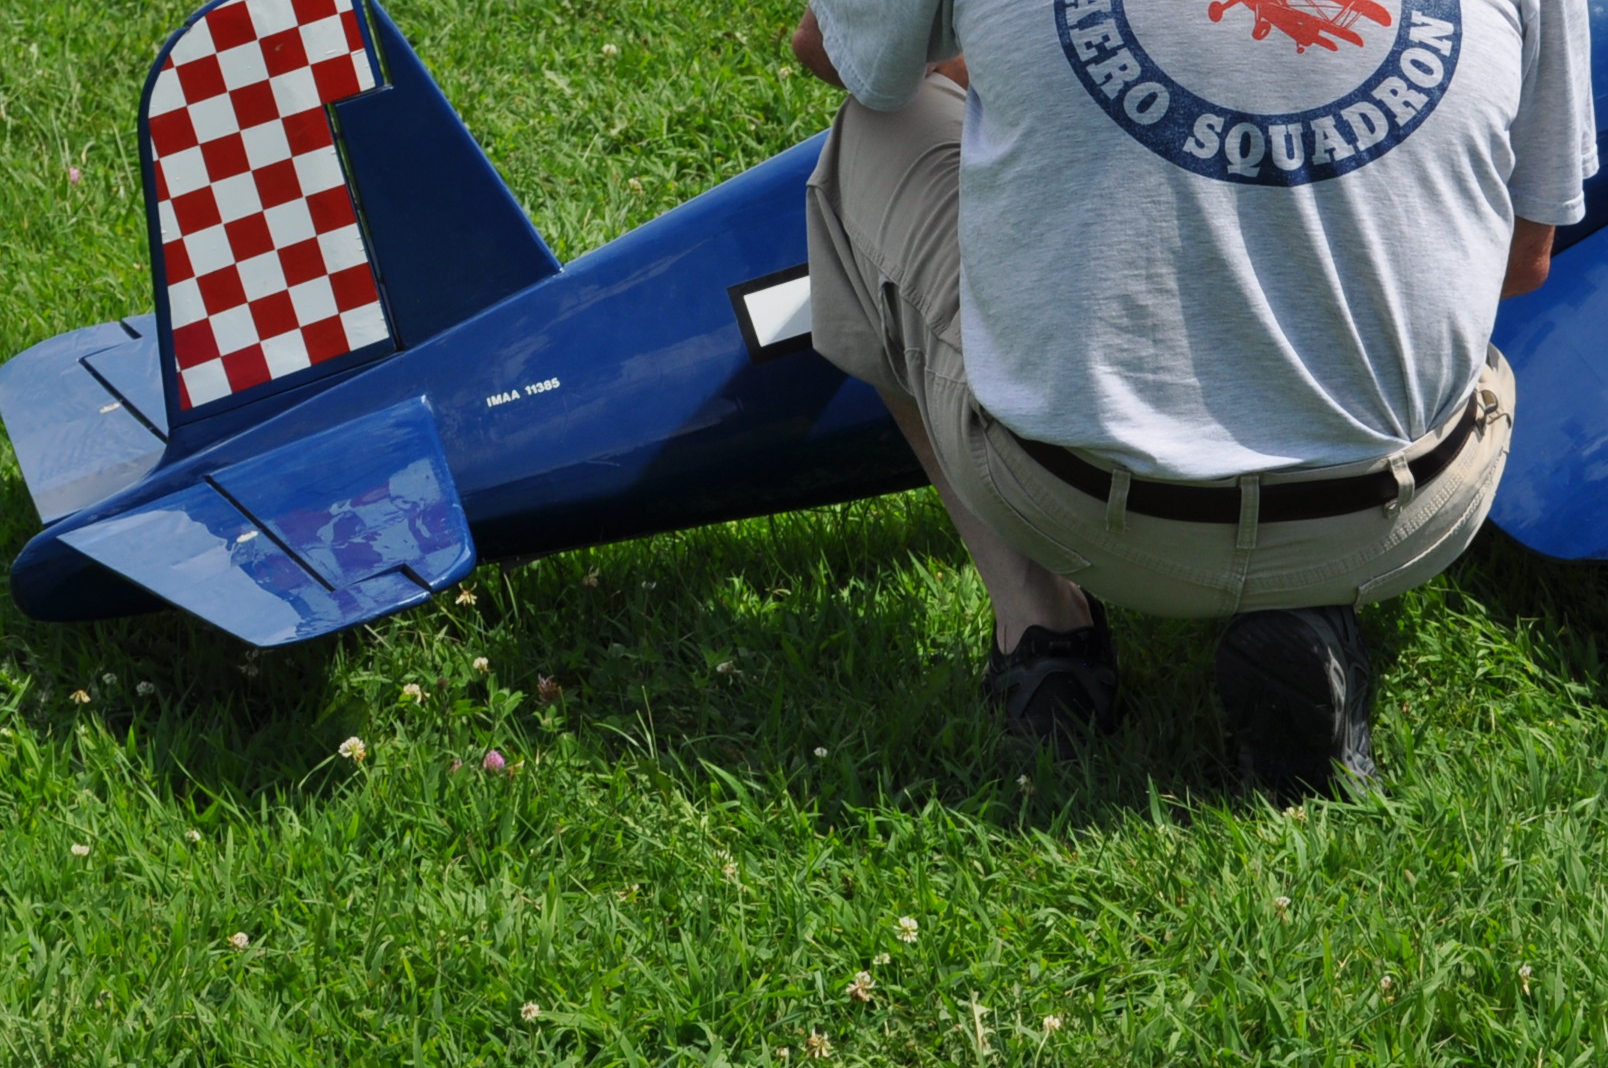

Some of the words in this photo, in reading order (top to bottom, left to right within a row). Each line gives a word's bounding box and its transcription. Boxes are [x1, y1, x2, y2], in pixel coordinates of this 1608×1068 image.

[1183, 10, 1455, 178] SQUADRON
[486, 389, 520, 408] IMAA
[525, 377, 561, 395] 11385
